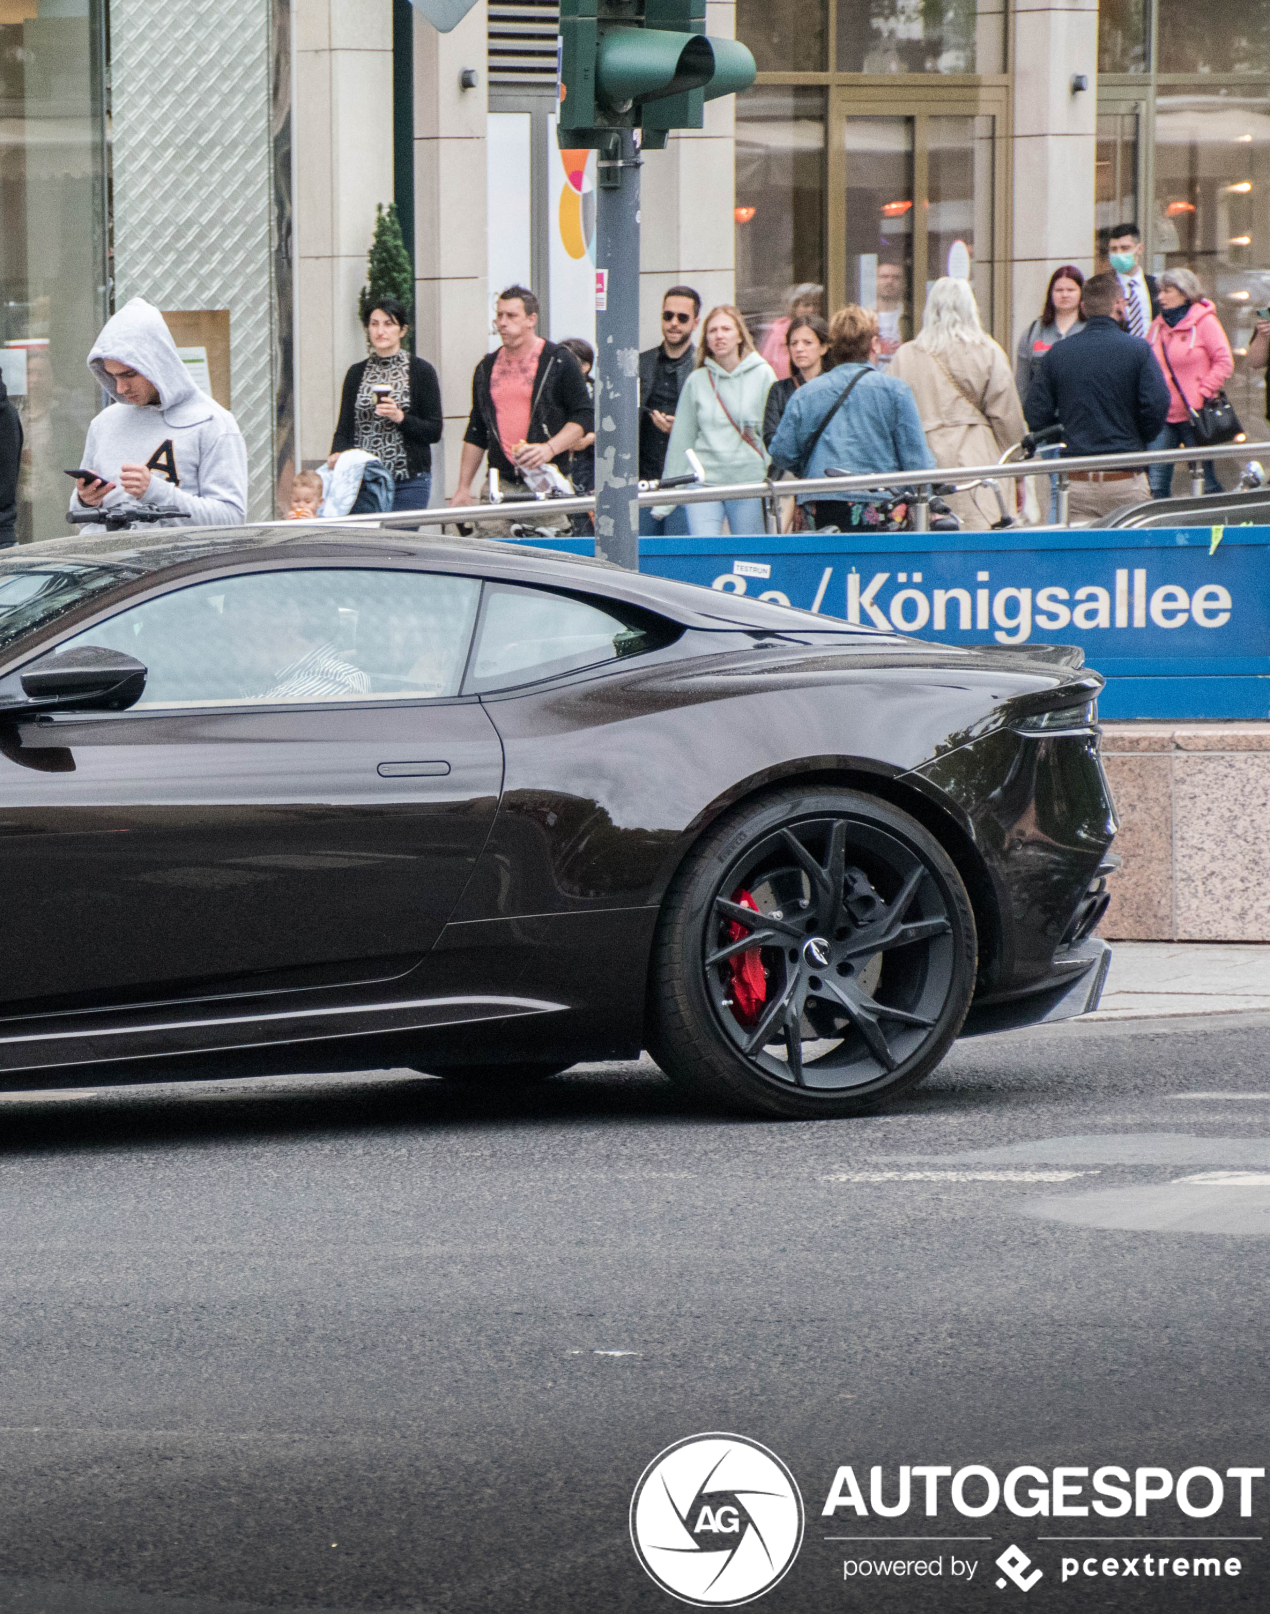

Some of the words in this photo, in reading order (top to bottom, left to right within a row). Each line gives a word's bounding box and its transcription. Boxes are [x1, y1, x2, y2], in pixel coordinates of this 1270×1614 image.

[144, 438, 181, 487] A
[736, 564, 768, 575] TESTRUN
[847, 567, 1232, 645] Königsallee
